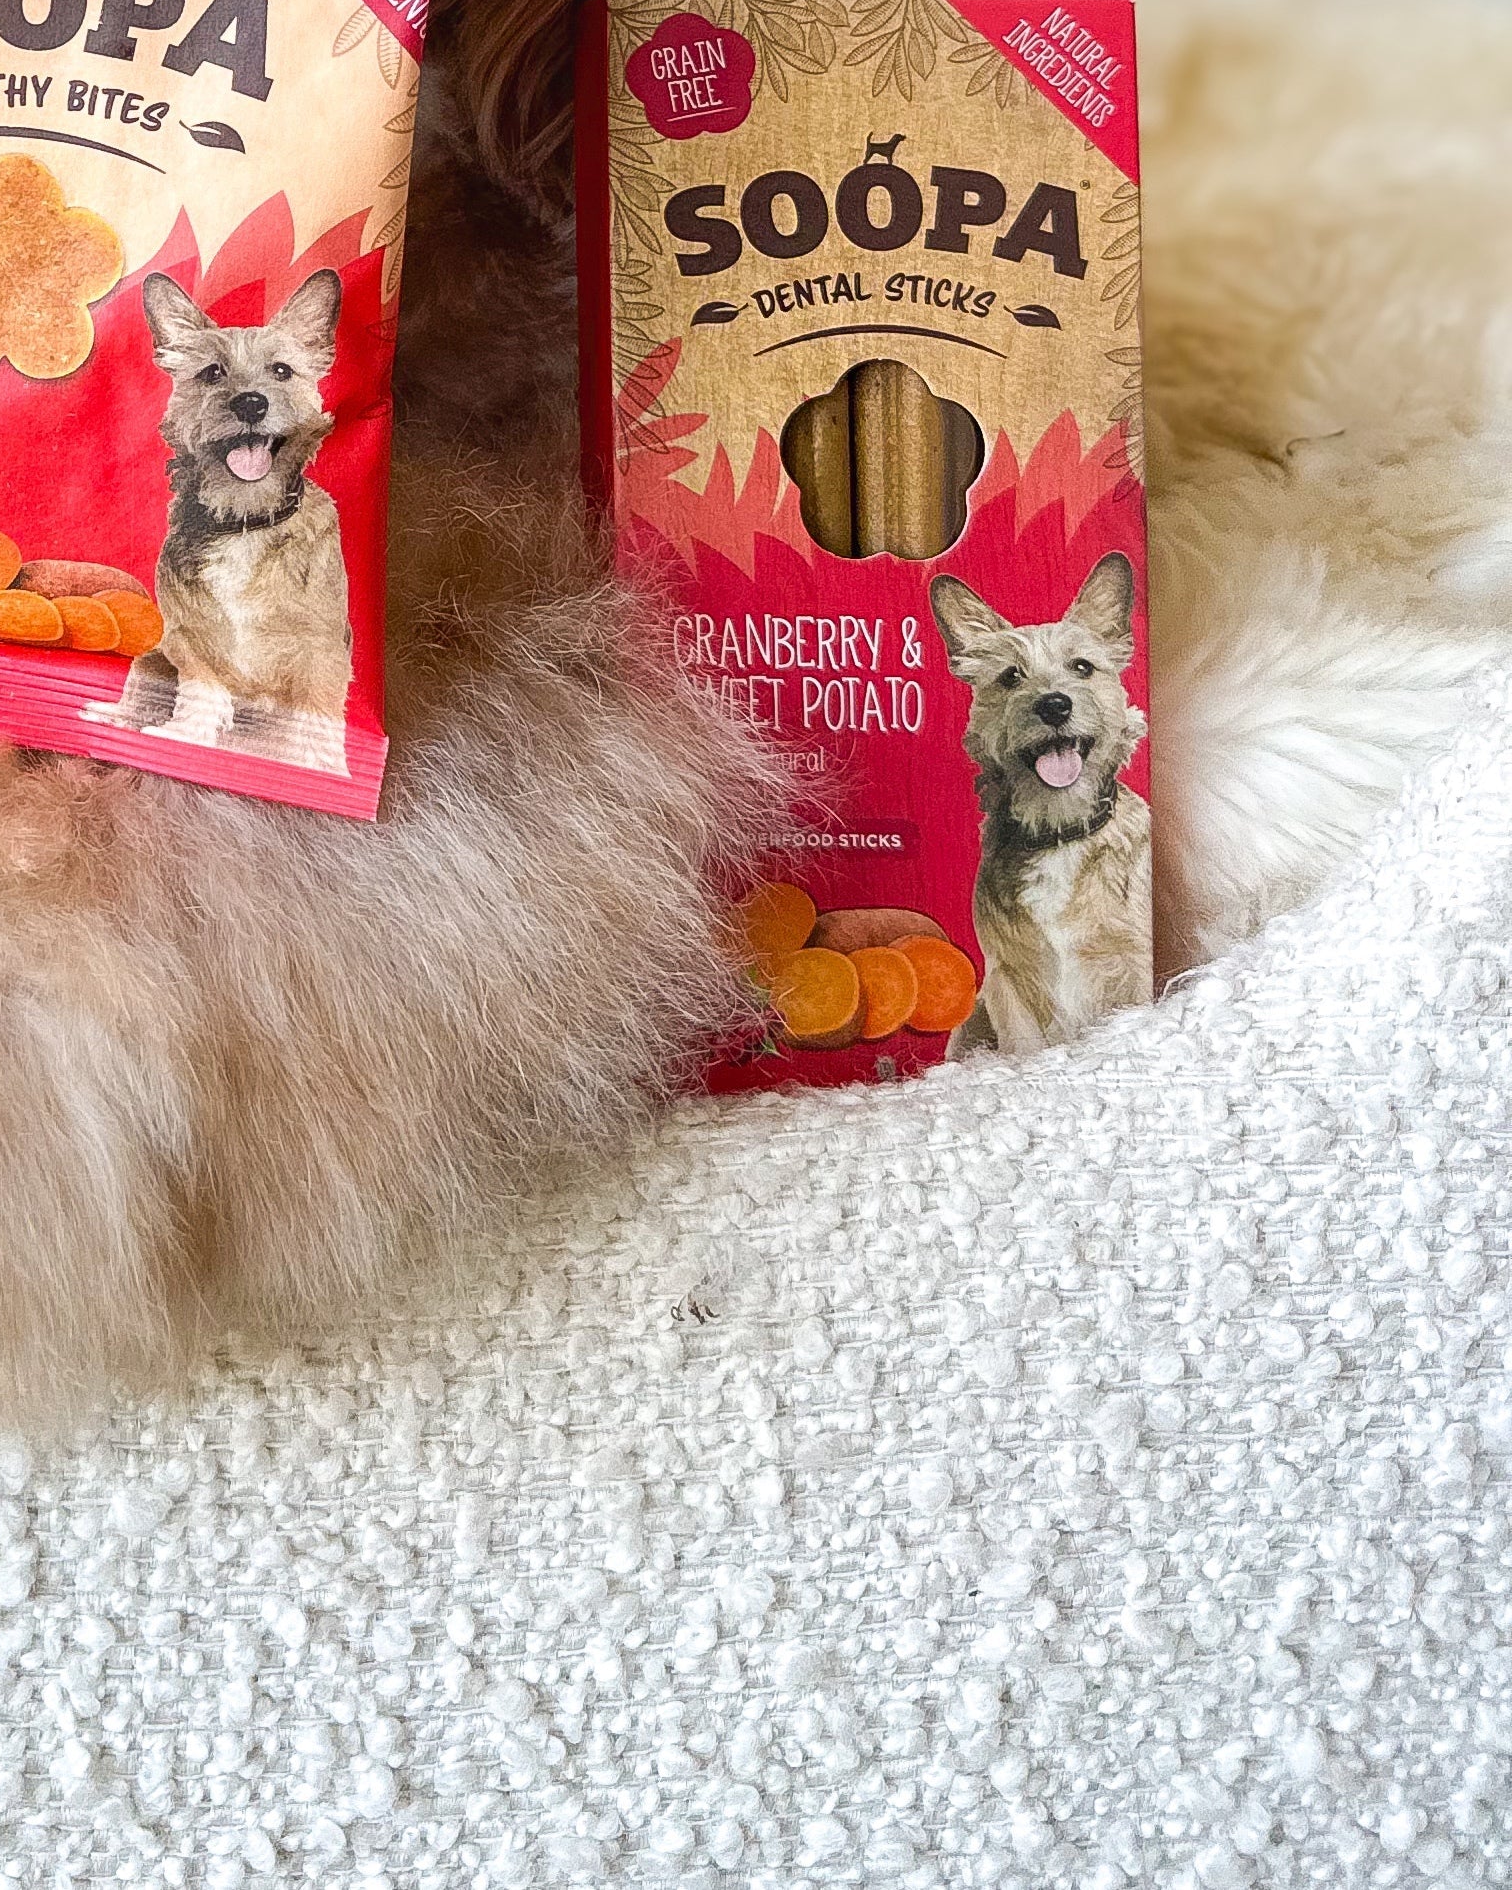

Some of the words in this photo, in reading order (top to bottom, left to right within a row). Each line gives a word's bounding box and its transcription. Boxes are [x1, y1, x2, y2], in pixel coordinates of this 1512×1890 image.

[650, 38, 727, 80] GRAIN
[1001, 18, 1116, 128] INGREDIENTS
[1040, 7, 1122, 91] NATURAL
[67, 79, 171, 132] BITES
[667, 74, 724, 113] FREE
[663, 163, 1089, 280] SOOPA
[750, 272, 872, 319] DENTAL
[884, 272, 997, 318] STICKS
[673, 613, 884, 670] CRANBERRY
[901, 616, 922, 668] &
[689, 674, 785, 731] WEET
[802, 676, 924, 732] POTATO
[839, 833, 903, 848] STICKS
